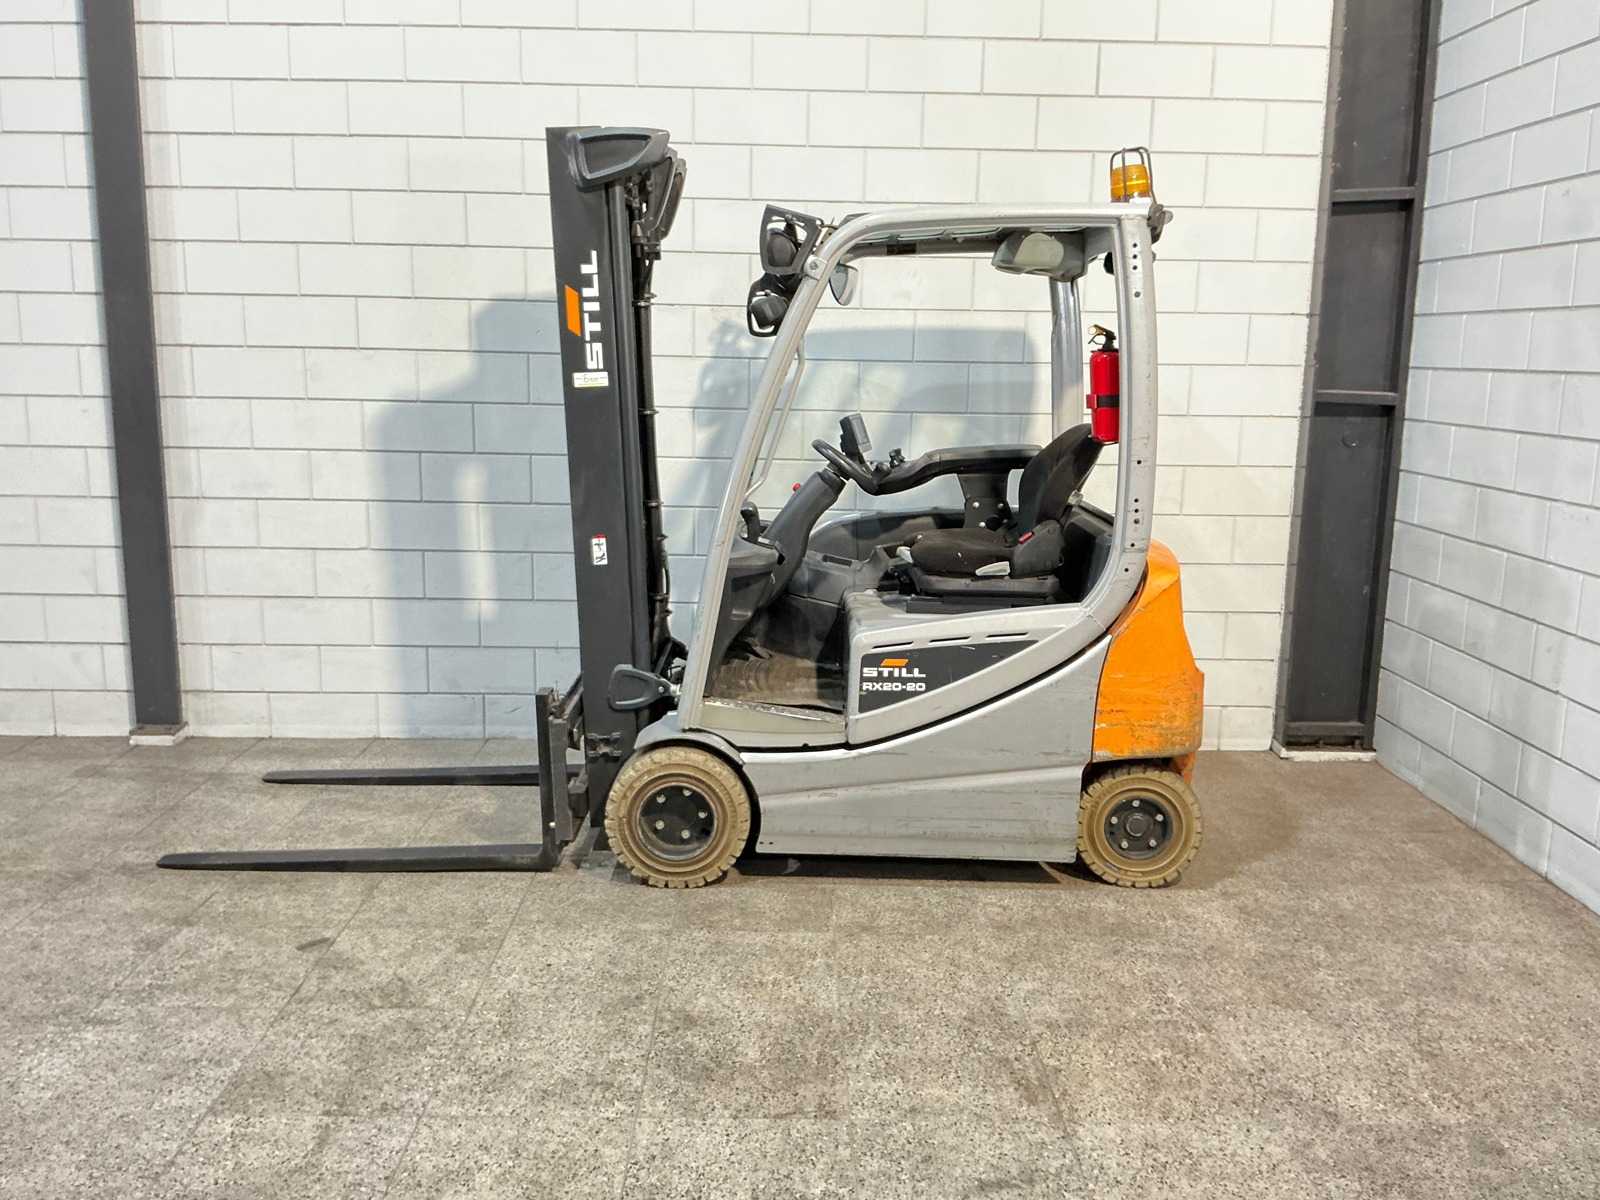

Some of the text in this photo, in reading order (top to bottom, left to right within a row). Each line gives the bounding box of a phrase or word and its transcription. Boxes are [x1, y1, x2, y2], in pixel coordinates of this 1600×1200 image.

[580, 249, 604, 370] STILL
[862, 667, 926, 678] STILL
[862, 682, 926, 692] RX20-20
